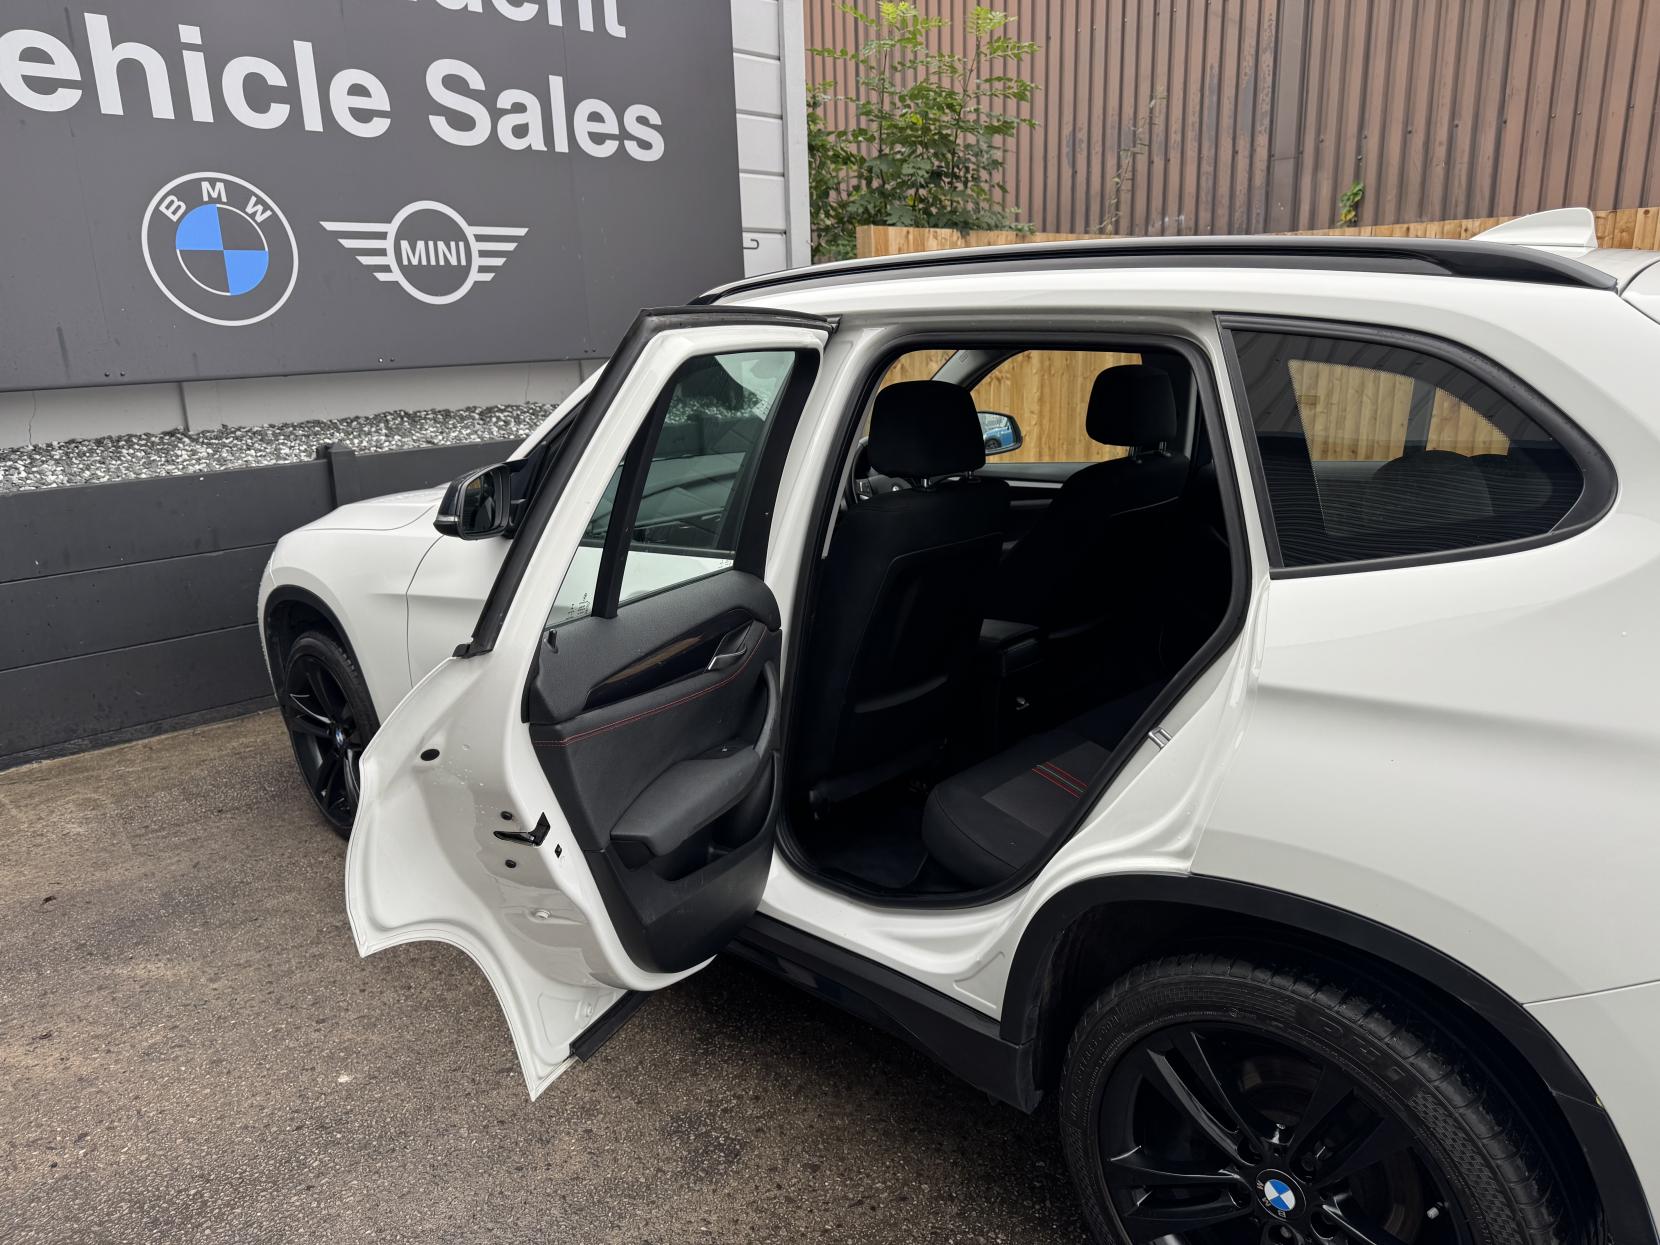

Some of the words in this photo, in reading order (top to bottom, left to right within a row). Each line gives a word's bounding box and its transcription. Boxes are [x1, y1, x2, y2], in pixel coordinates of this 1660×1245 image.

[424, 58, 665, 162] Sales
[158, 181, 273, 223] BMW
[400, 239, 467, 266] MINI
